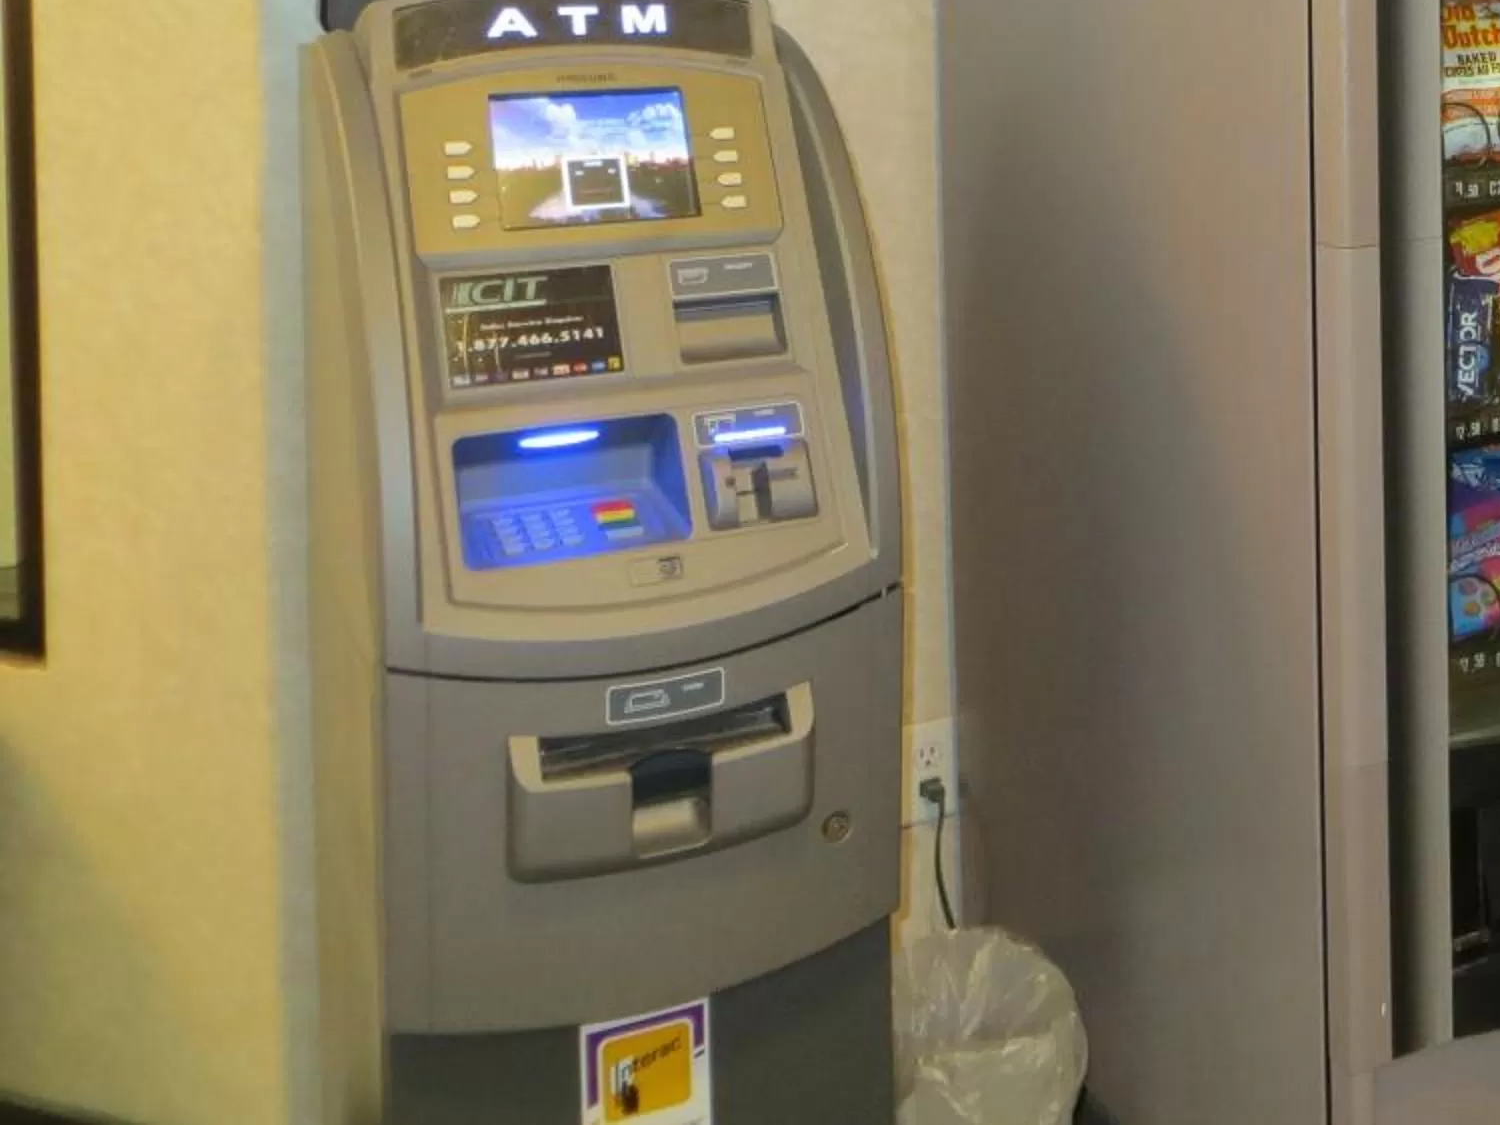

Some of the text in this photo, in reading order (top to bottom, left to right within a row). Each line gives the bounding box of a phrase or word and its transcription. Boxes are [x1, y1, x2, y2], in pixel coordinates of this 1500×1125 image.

[487, 4, 668, 38] ATM
[1457, 51, 1497, 65] BAKED
[1457, 311, 1478, 397] VECTOR
